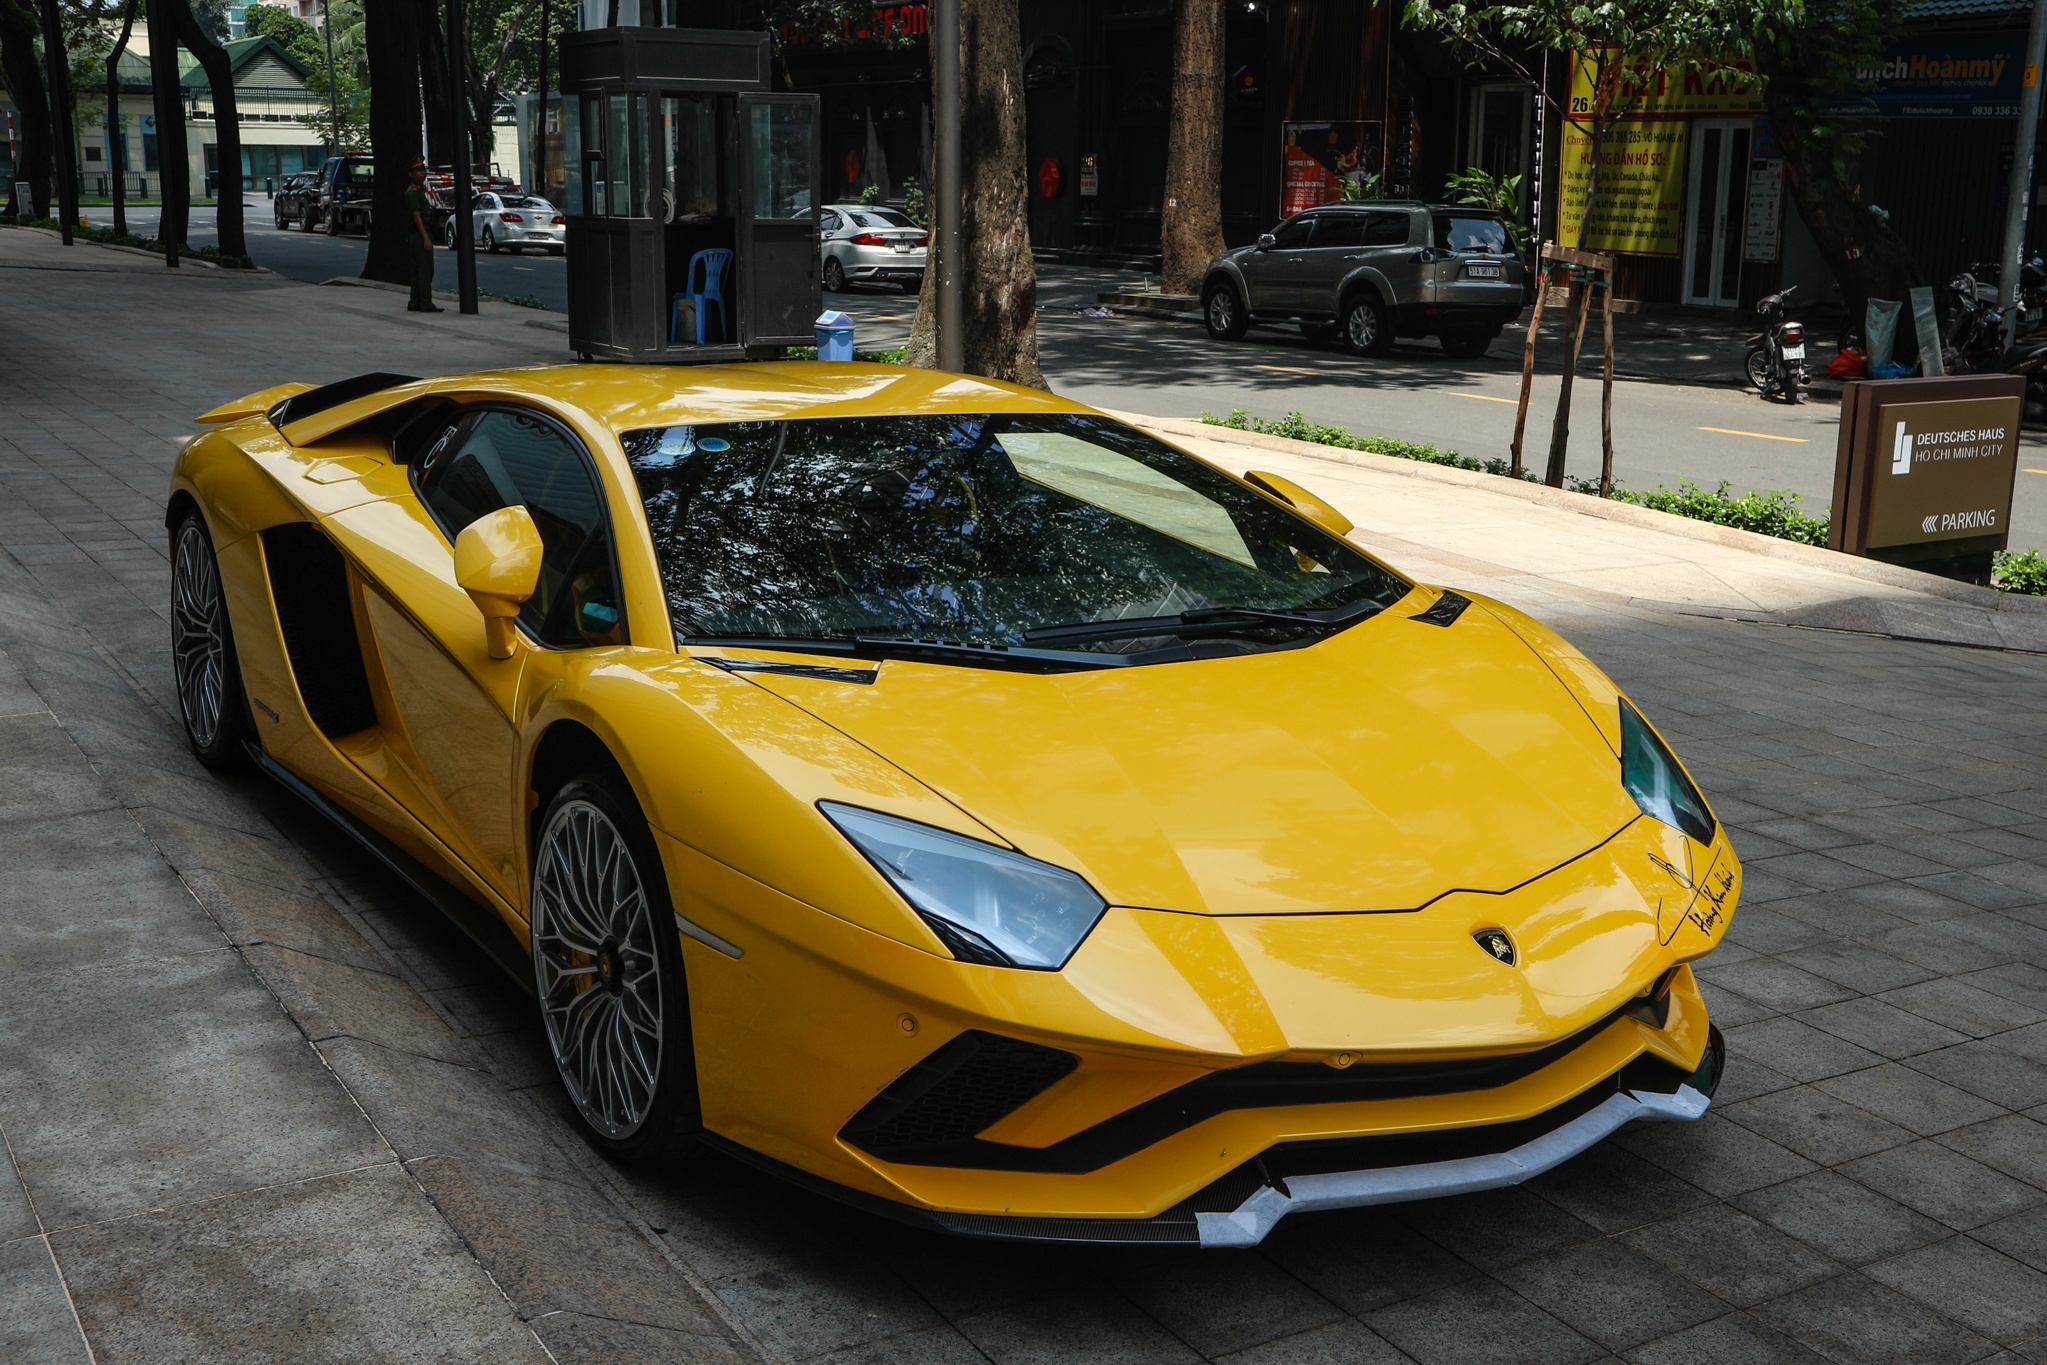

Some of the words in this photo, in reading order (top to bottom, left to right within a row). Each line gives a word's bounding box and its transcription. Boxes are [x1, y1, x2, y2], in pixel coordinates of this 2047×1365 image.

[1572, 97, 1589, 113] 26
[1972, 106, 1993, 116] 0938
[1994, 106, 2011, 116] 336
[1602, 130, 1615, 144] 906
[1629, 131, 1641, 144] 285
[1168, 197, 1178, 207] 12
[1844, 248, 1861, 260] 10
[1917, 429, 1976, 446] DEUTSCHES
[1977, 427, 2005, 441] HAUS
[1915, 450, 1931, 462] HO
[1933, 448, 1951, 461] CHI
[1953, 446, 1979, 460] MINH
[1980, 444, 2003, 457] CITY
[1941, 509, 1996, 532] PARKING
